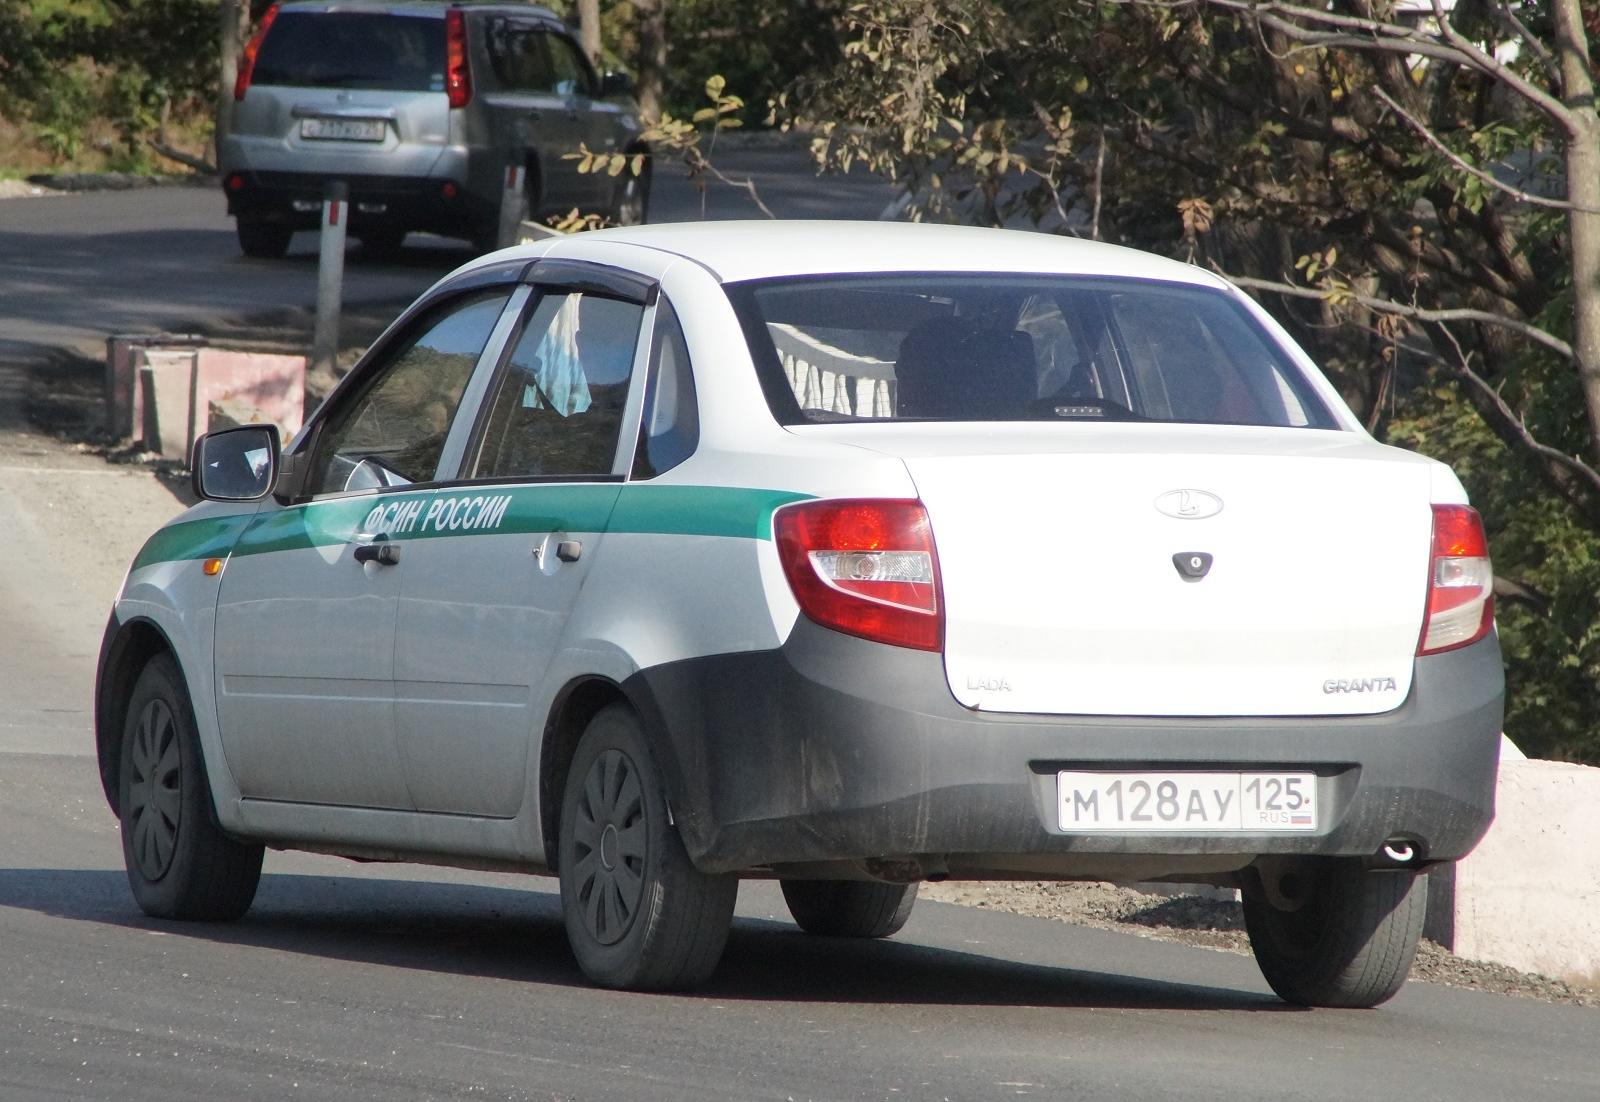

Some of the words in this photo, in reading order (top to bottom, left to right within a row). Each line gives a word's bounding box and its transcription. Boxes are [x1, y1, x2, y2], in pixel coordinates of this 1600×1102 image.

[363, 500, 426, 533] ФСИН
[420, 495, 513, 532] РОССИИ
[966, 675, 1012, 692] LADA
[1322, 677, 1397, 694] GRANTA
[1246, 778, 1303, 810] 125
[1259, 811, 1289, 823] RUS
